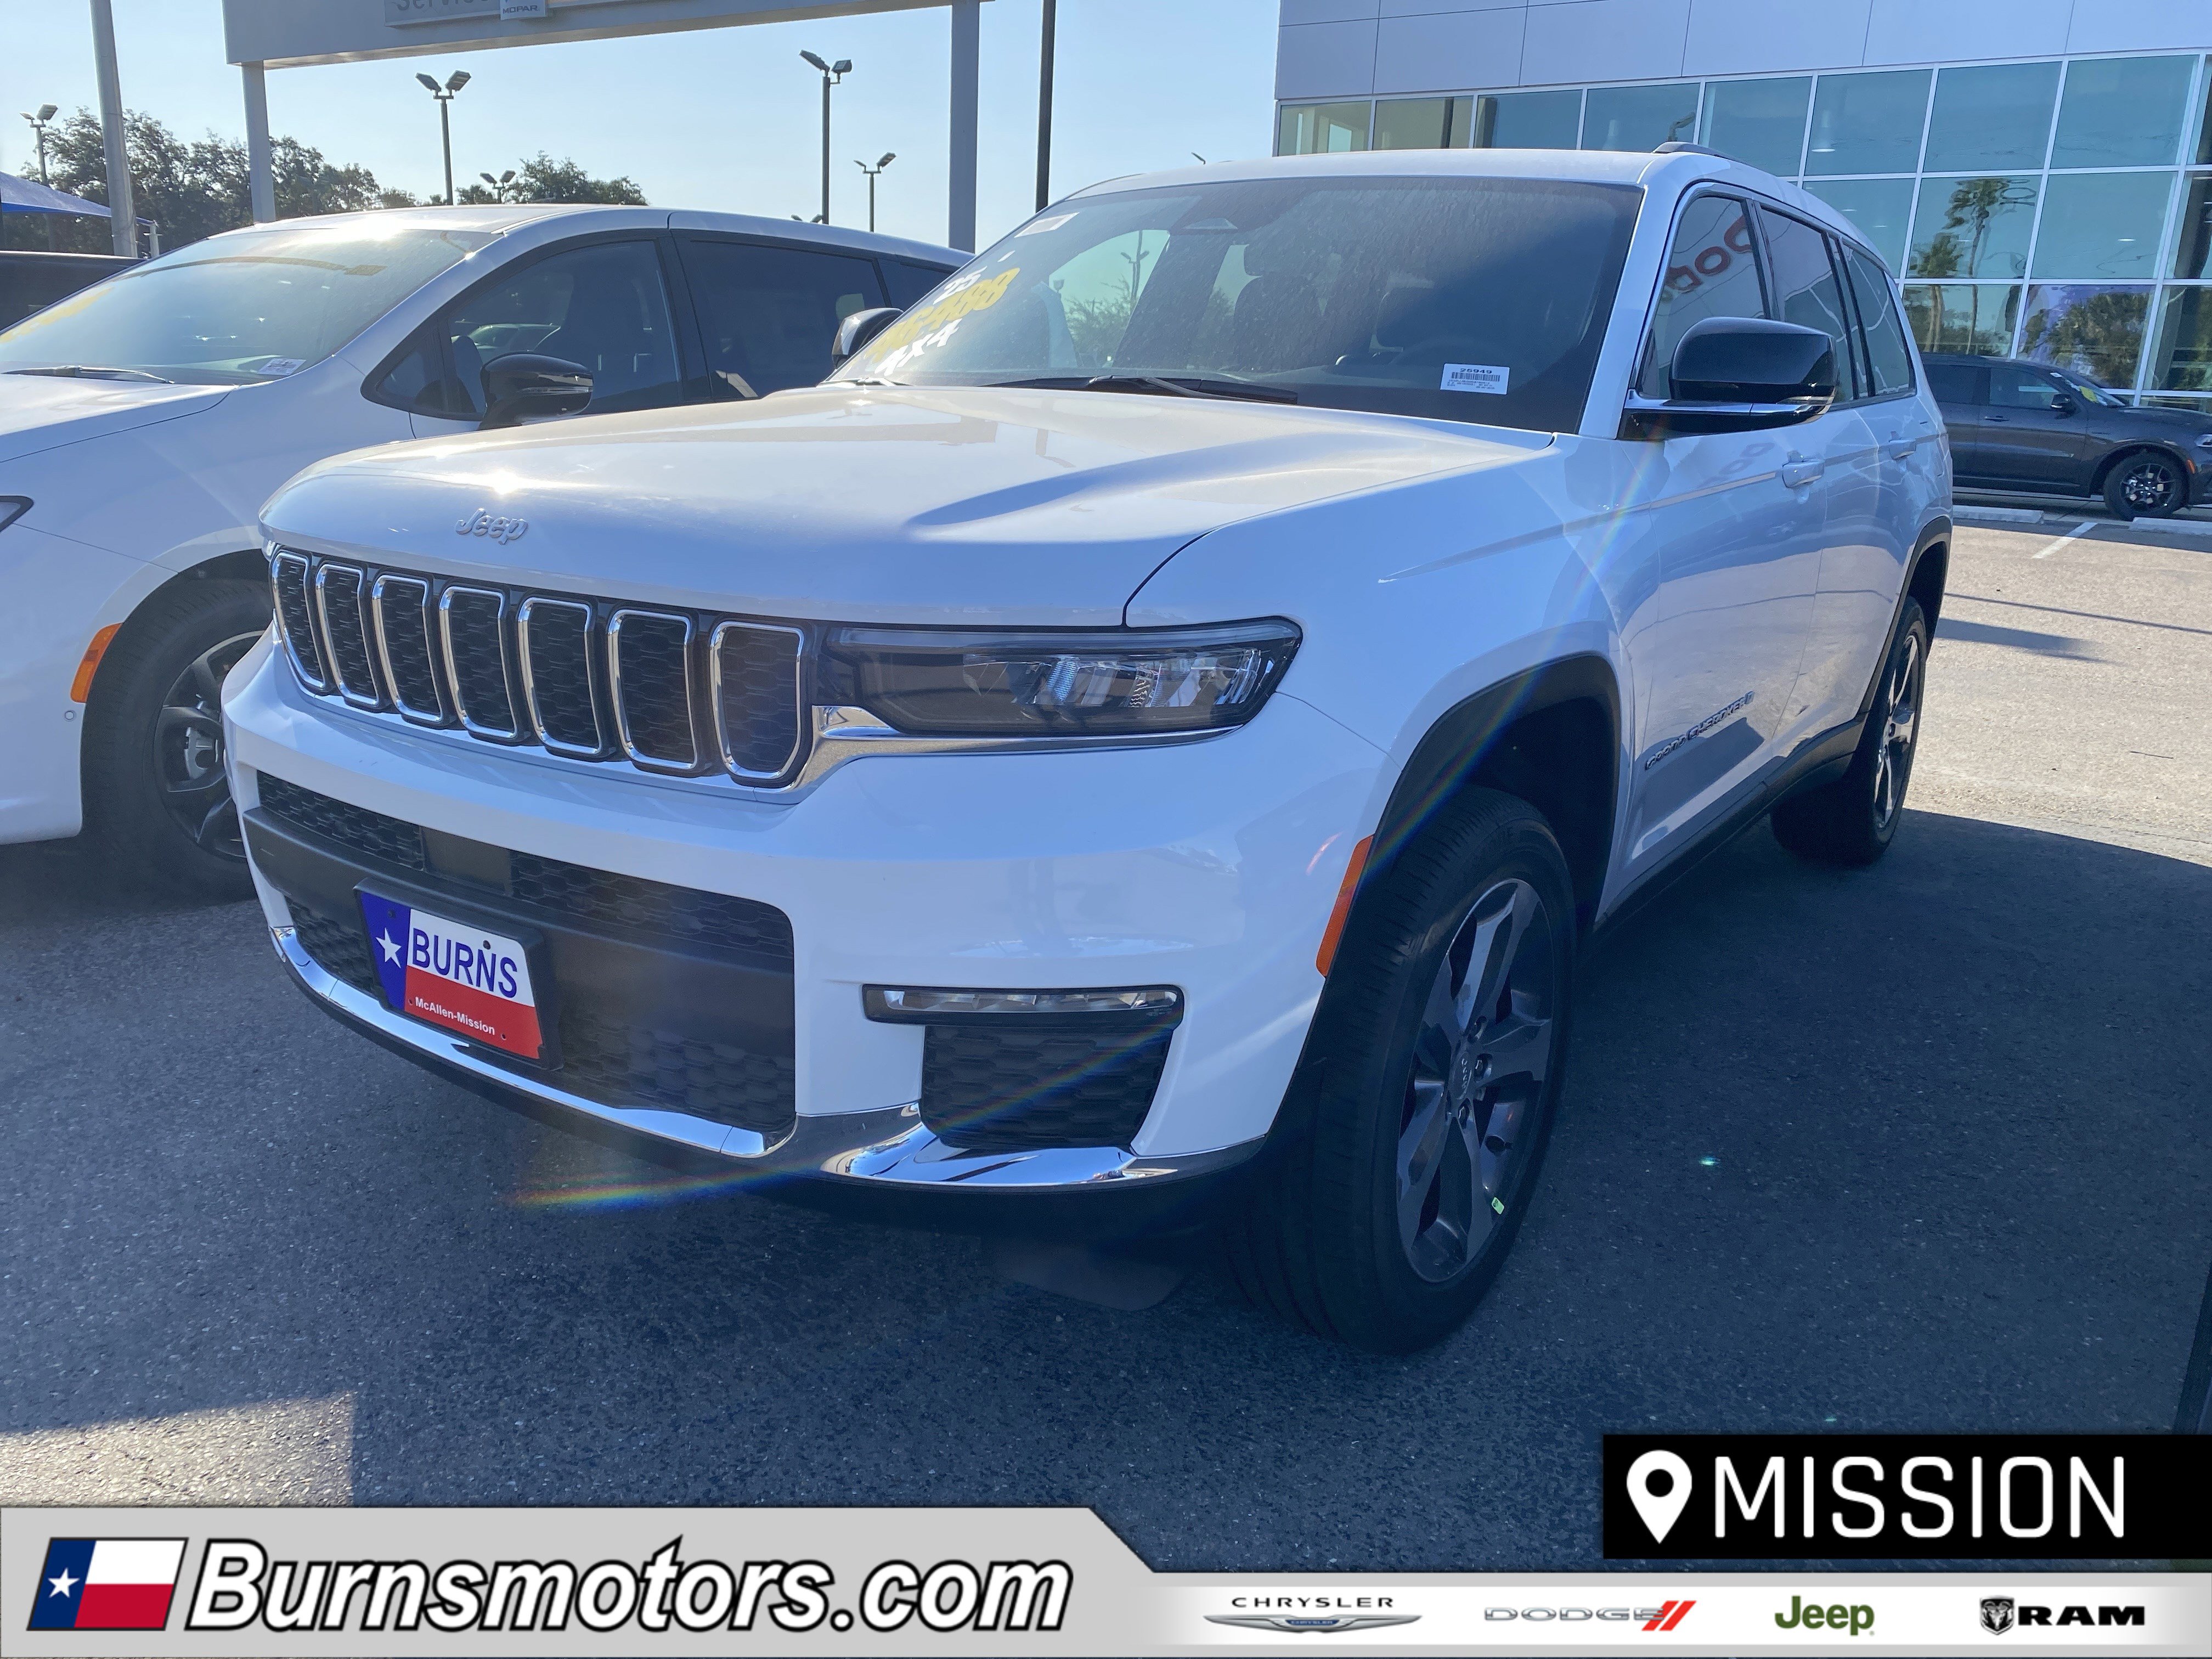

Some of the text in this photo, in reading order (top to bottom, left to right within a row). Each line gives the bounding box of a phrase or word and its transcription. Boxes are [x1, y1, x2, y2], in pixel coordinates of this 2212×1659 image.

[502, 5, 538, 14] MOPAR
[455, 508, 528, 545] Jeep
[412, 928, 518, 998] BURNS
[415, 996, 495, 1036] McAllen-Mission
